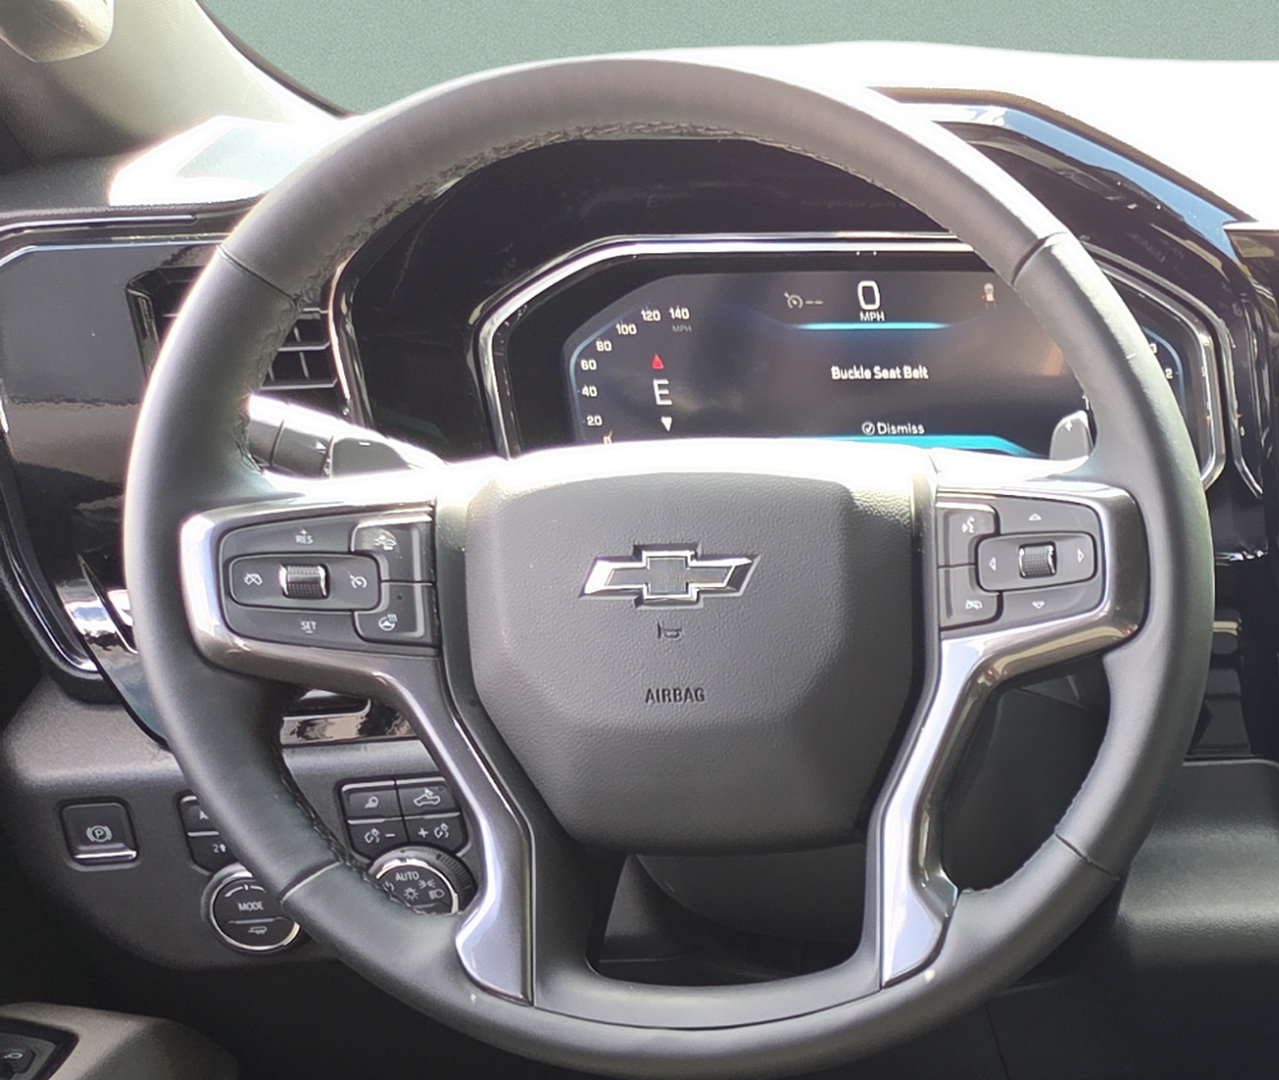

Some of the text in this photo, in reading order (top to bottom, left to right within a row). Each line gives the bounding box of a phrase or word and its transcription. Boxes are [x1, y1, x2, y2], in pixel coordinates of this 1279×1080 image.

[857, 280, 881, 310] 0
[641, 309, 661, 321] 120
[669, 306, 690, 319] 140
[860, 311, 885, 322] MPH
[616, 323, 637, 335] 100
[596, 340, 612, 351] 80
[581, 359, 597, 370] 60
[831, 364, 929, 380] Buckle Seat Belt
[1165, 368, 1173, 379] 2
[582, 385, 598, 397] 40
[652, 378, 673, 405] E
[586, 415, 603, 426] 20
[877, 421, 925, 435] Dismiss
[296, 535, 313, 544] RES
[301, 621, 317, 630] SET
[645, 688, 705, 704] AIRBAG
[395, 871, 420, 882] AUTO
[237, 901, 264, 911] MODE
